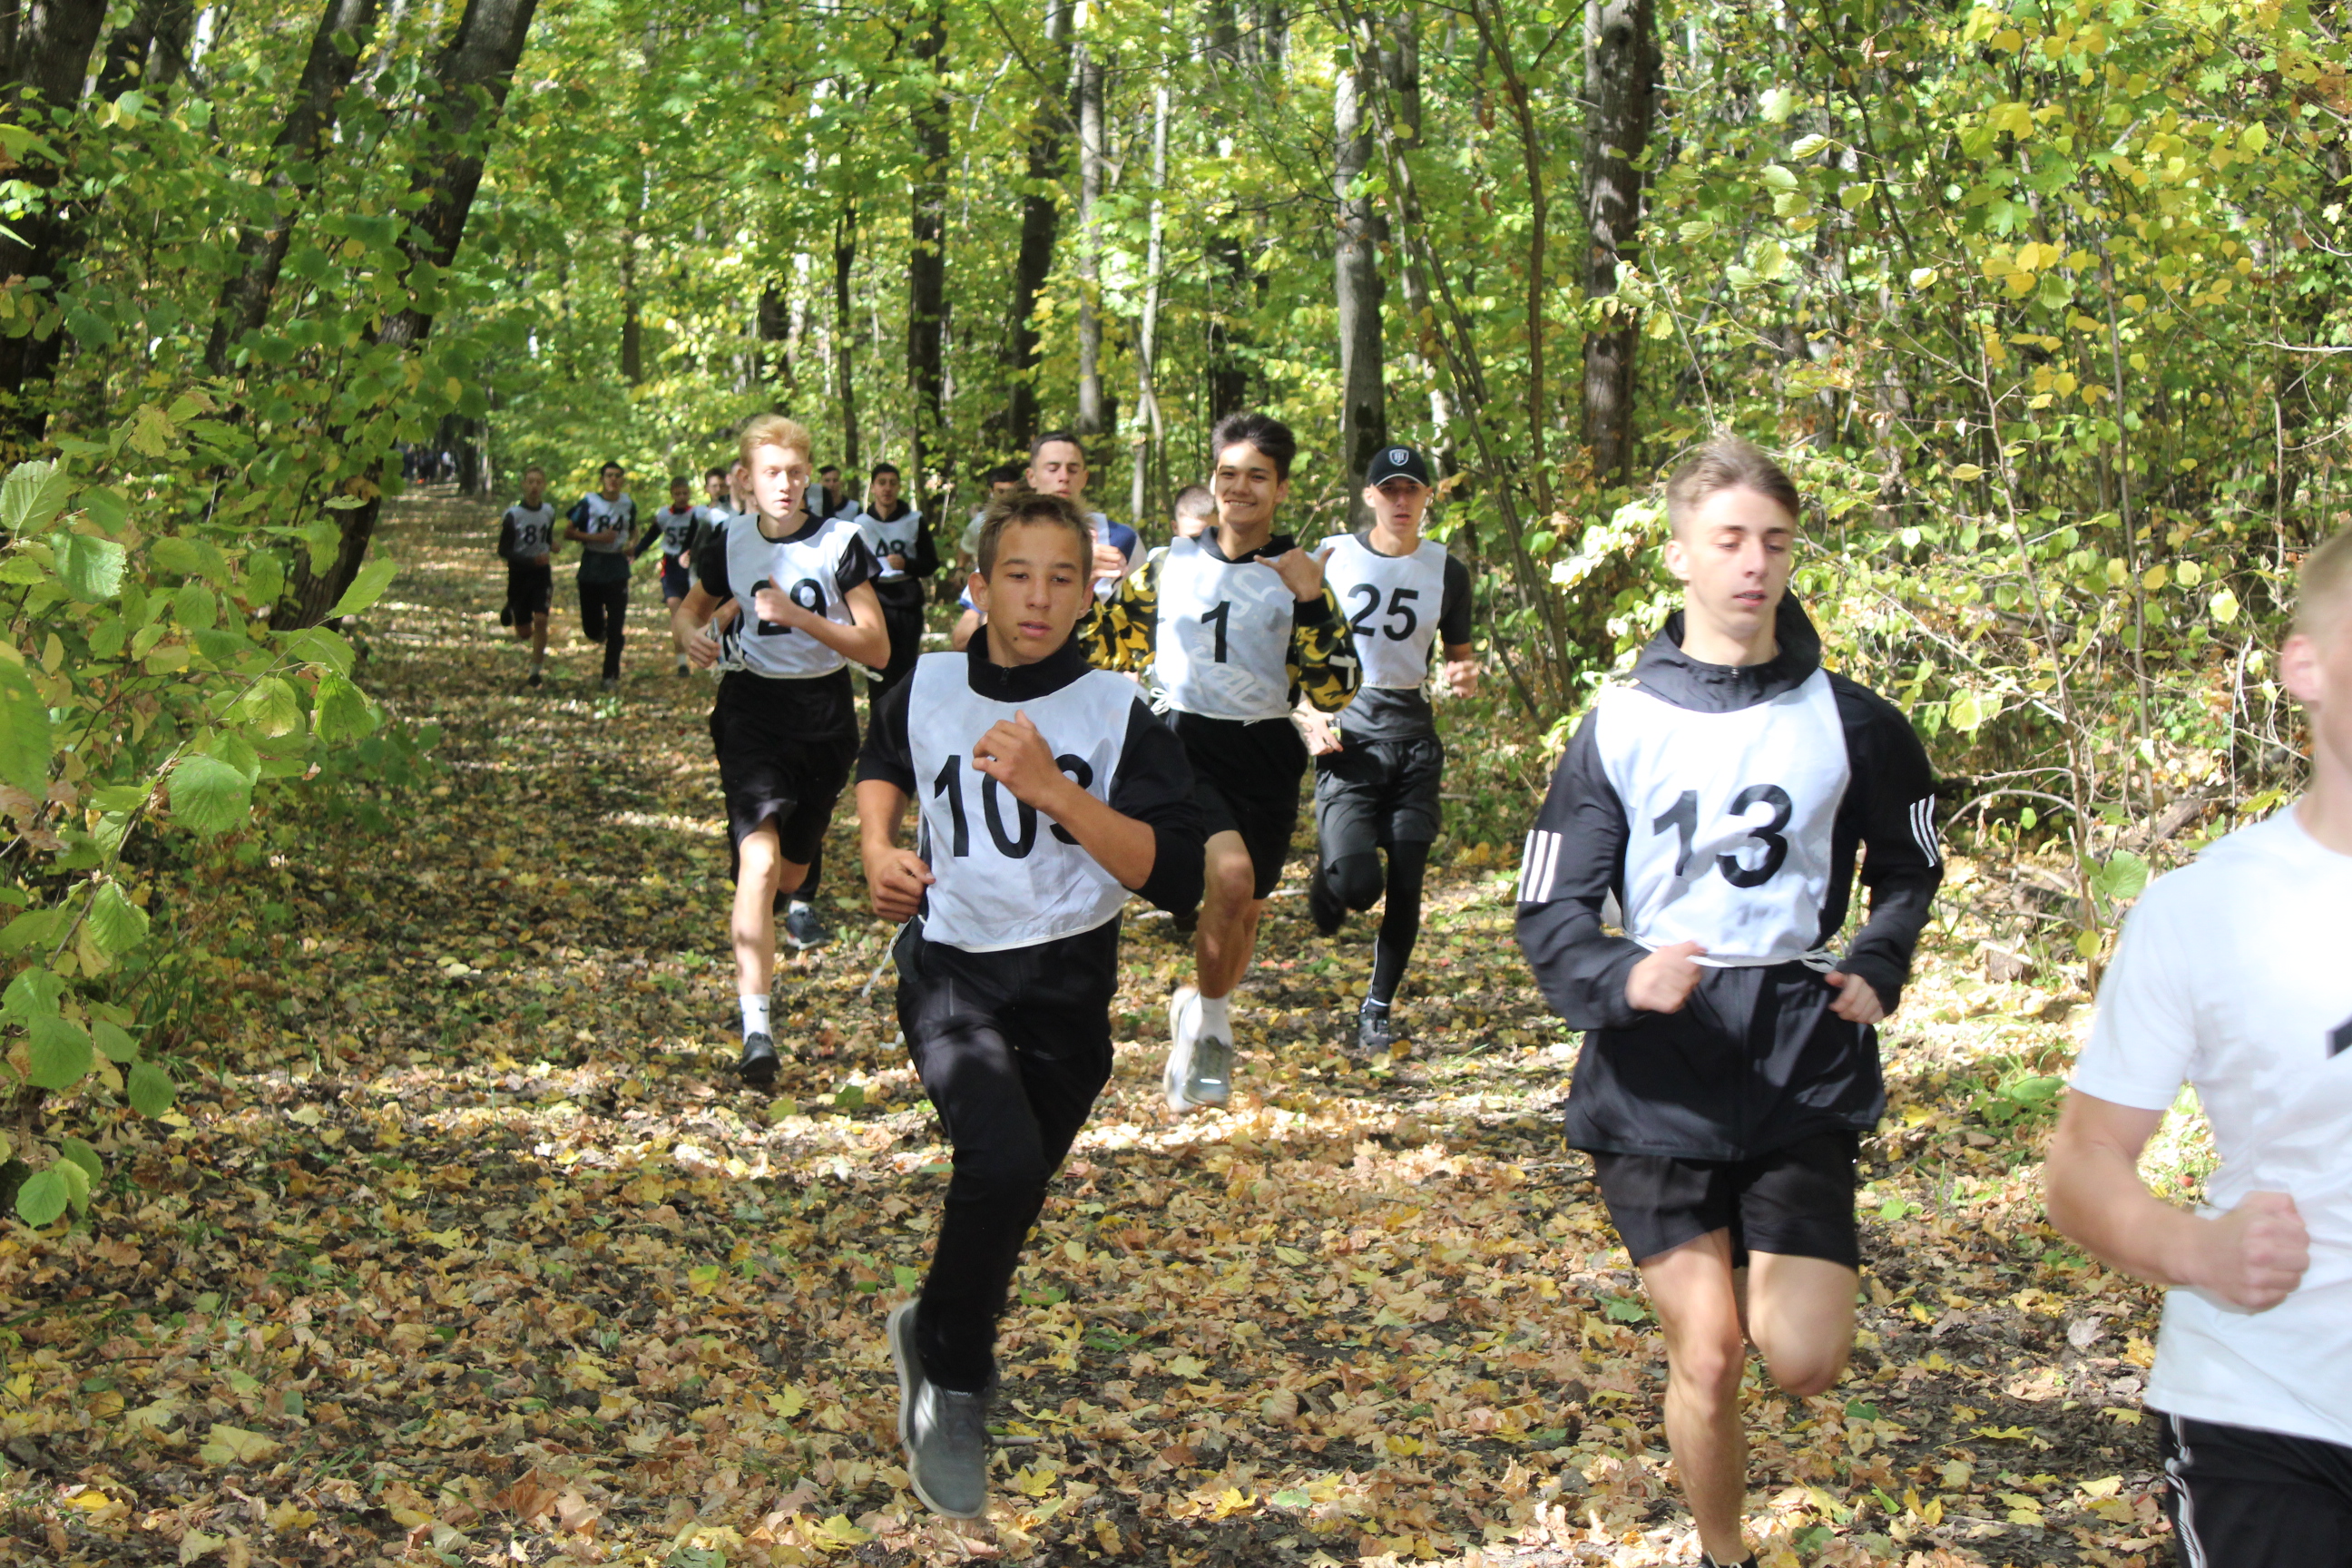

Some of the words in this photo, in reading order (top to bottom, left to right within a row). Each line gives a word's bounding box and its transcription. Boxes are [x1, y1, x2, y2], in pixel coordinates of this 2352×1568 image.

[1200, 601, 1231, 663] 1
[1348, 583, 1419, 642] 25
[1653, 783, 1792, 888] 13
